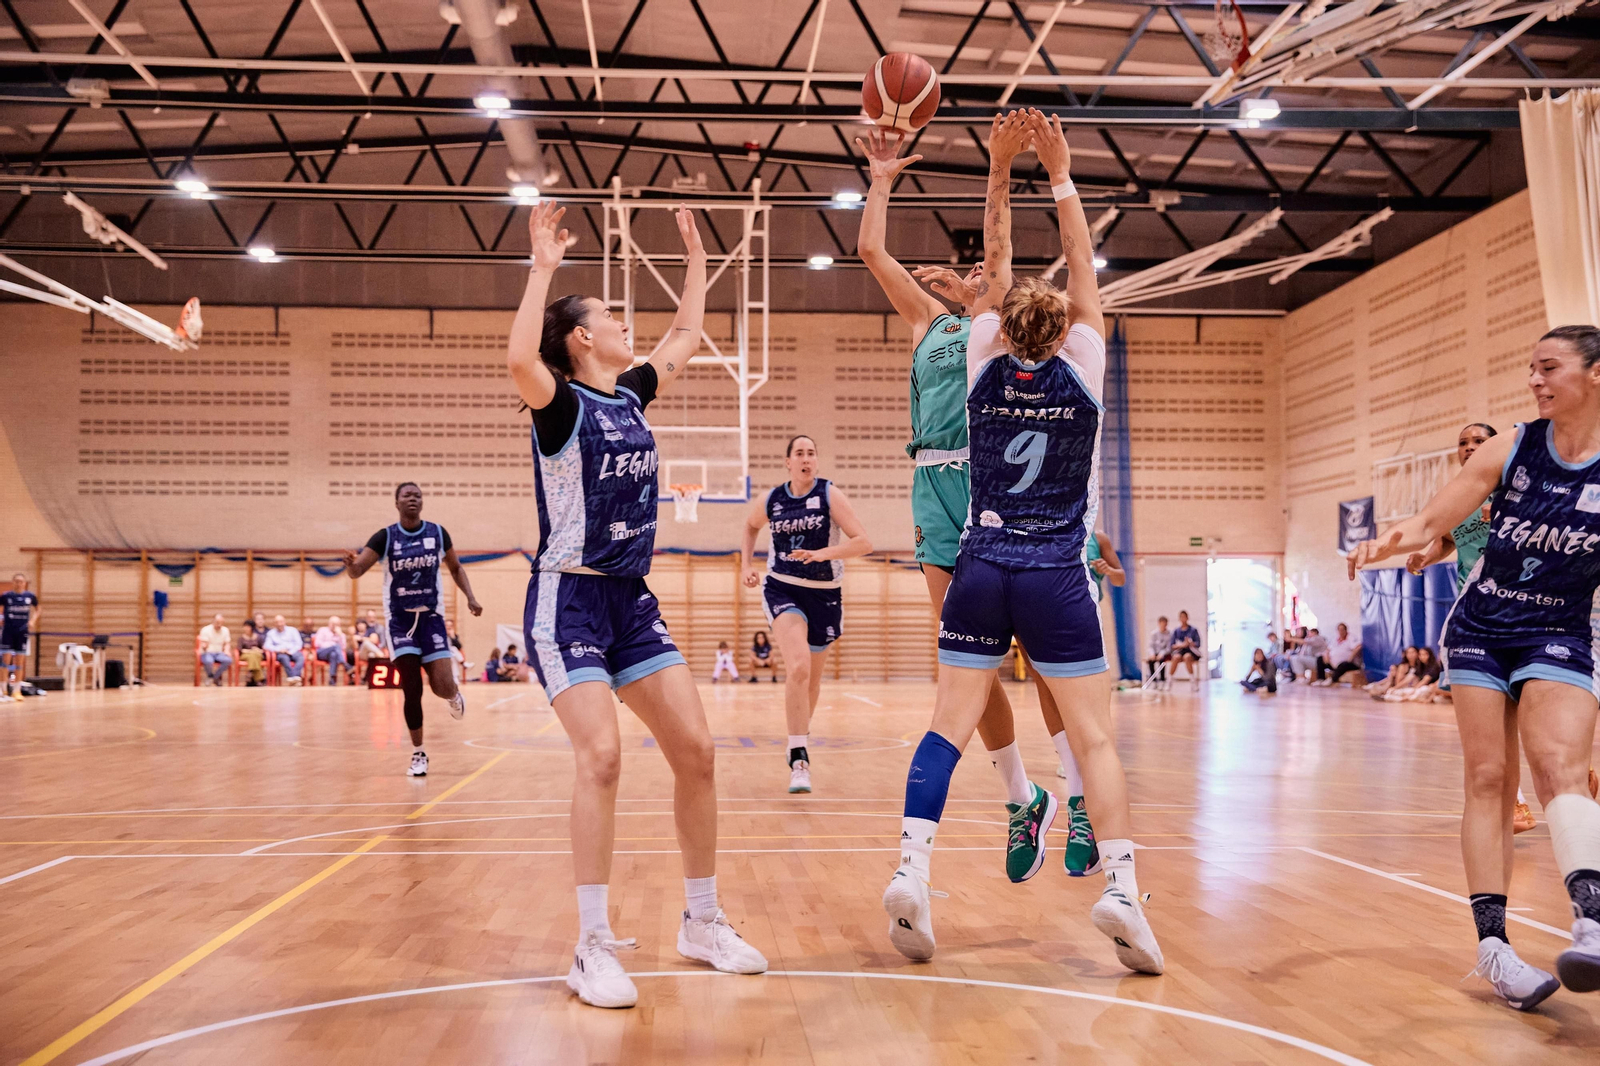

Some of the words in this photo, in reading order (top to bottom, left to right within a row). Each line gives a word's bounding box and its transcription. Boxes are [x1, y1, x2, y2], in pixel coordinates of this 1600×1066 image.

[1015, 390, 1046, 400] Leganés
[598, 449, 659, 482] LEGAN
[1004, 430, 1048, 493] 9
[638, 484, 651, 511] 4
[789, 534, 805, 549] 12
[411, 571, 421, 585] 2
[1519, 557, 1543, 582] 8
